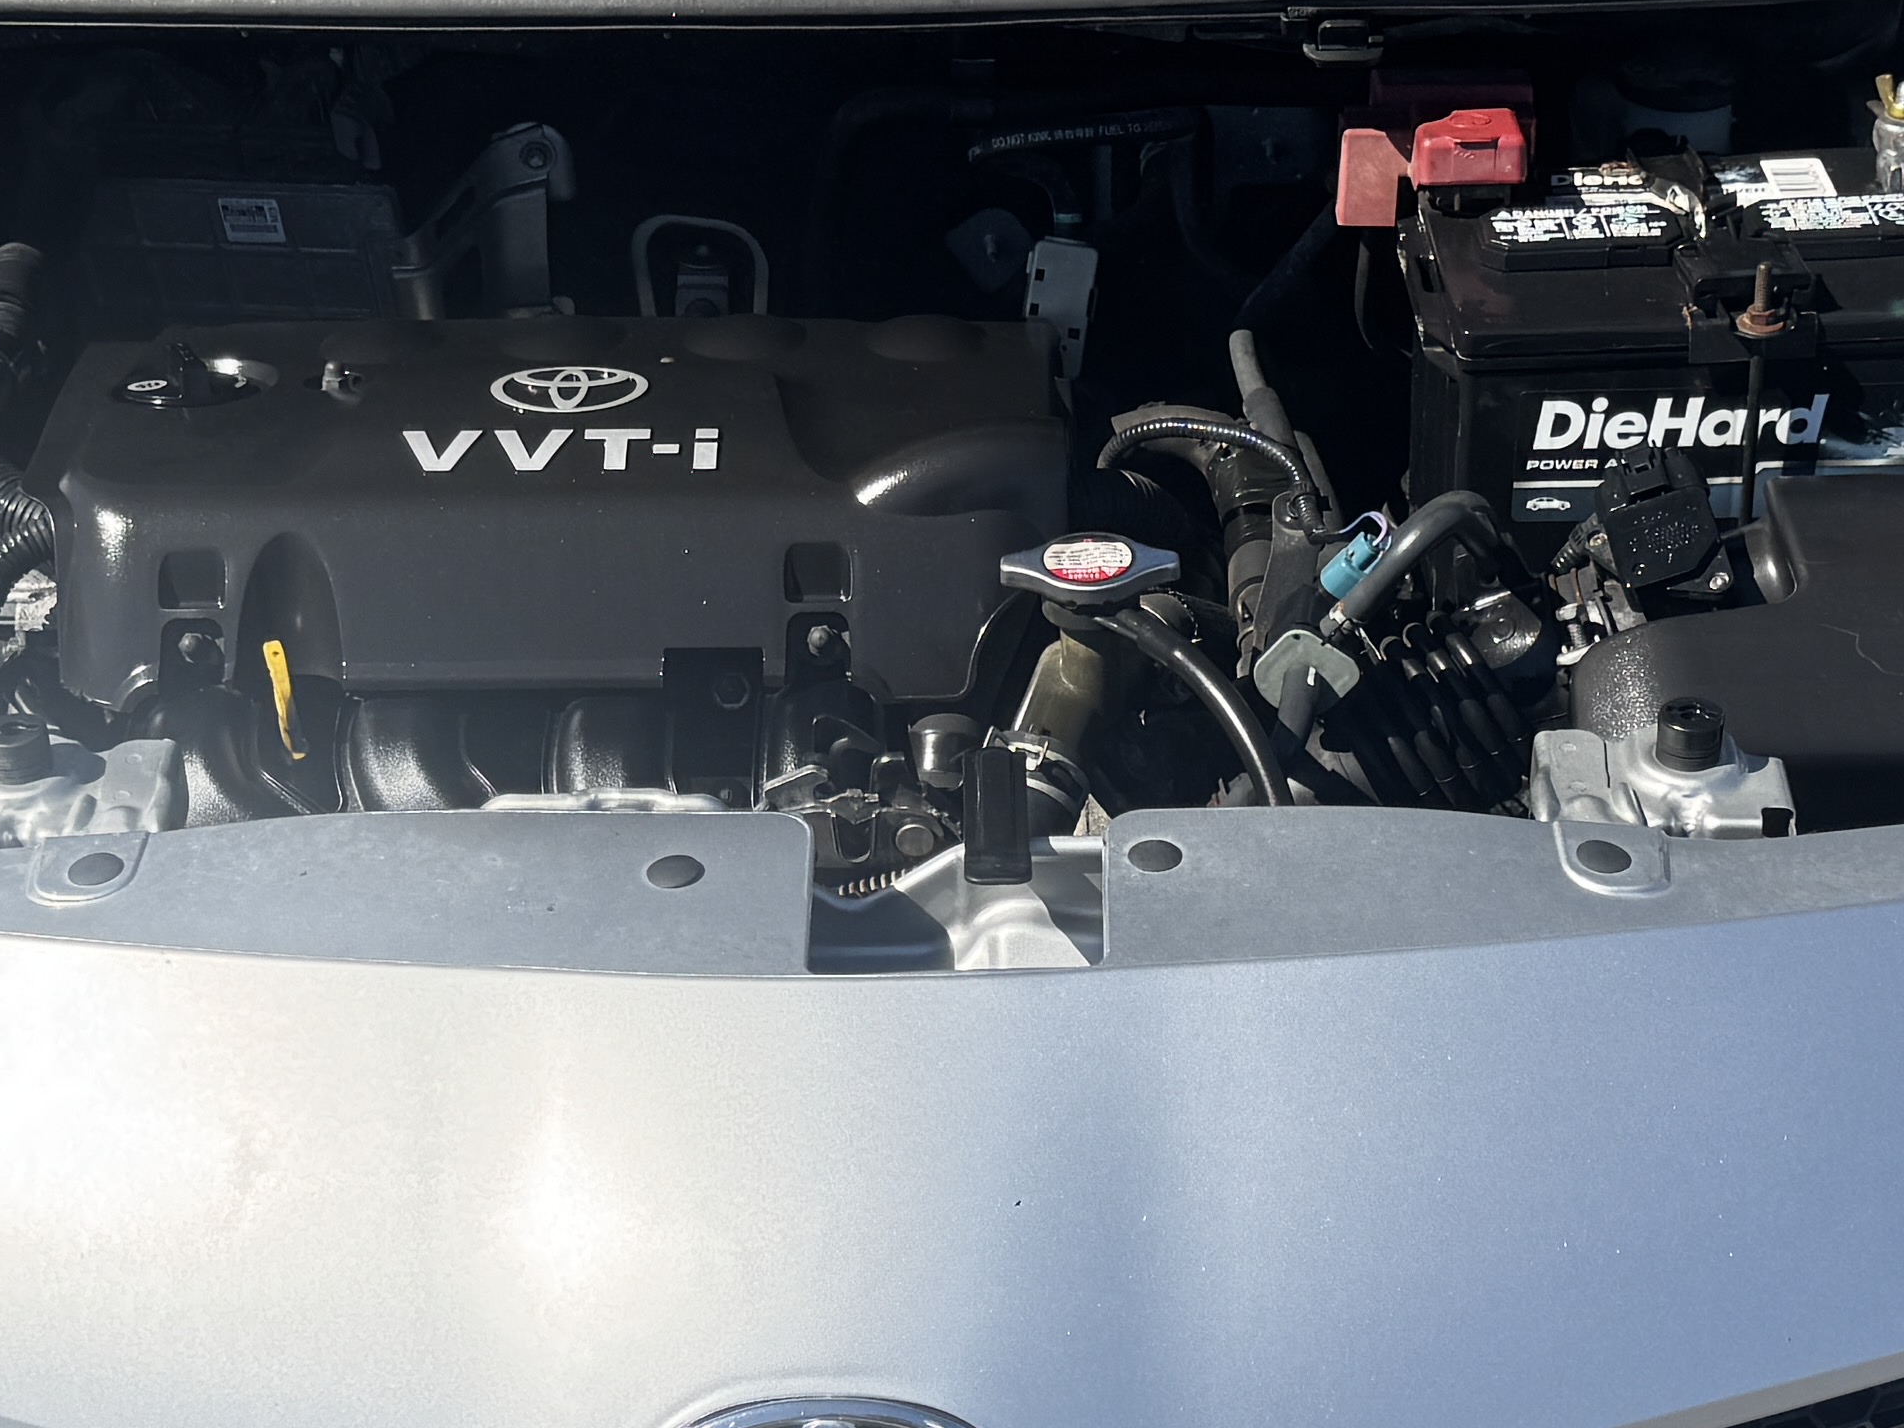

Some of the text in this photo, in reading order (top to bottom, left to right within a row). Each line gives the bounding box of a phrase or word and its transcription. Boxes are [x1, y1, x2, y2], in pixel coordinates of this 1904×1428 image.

[1532, 393, 1831, 450] DieHard
[402, 428, 720, 472] VVT-i
[1526, 458, 1599, 471] POWER
